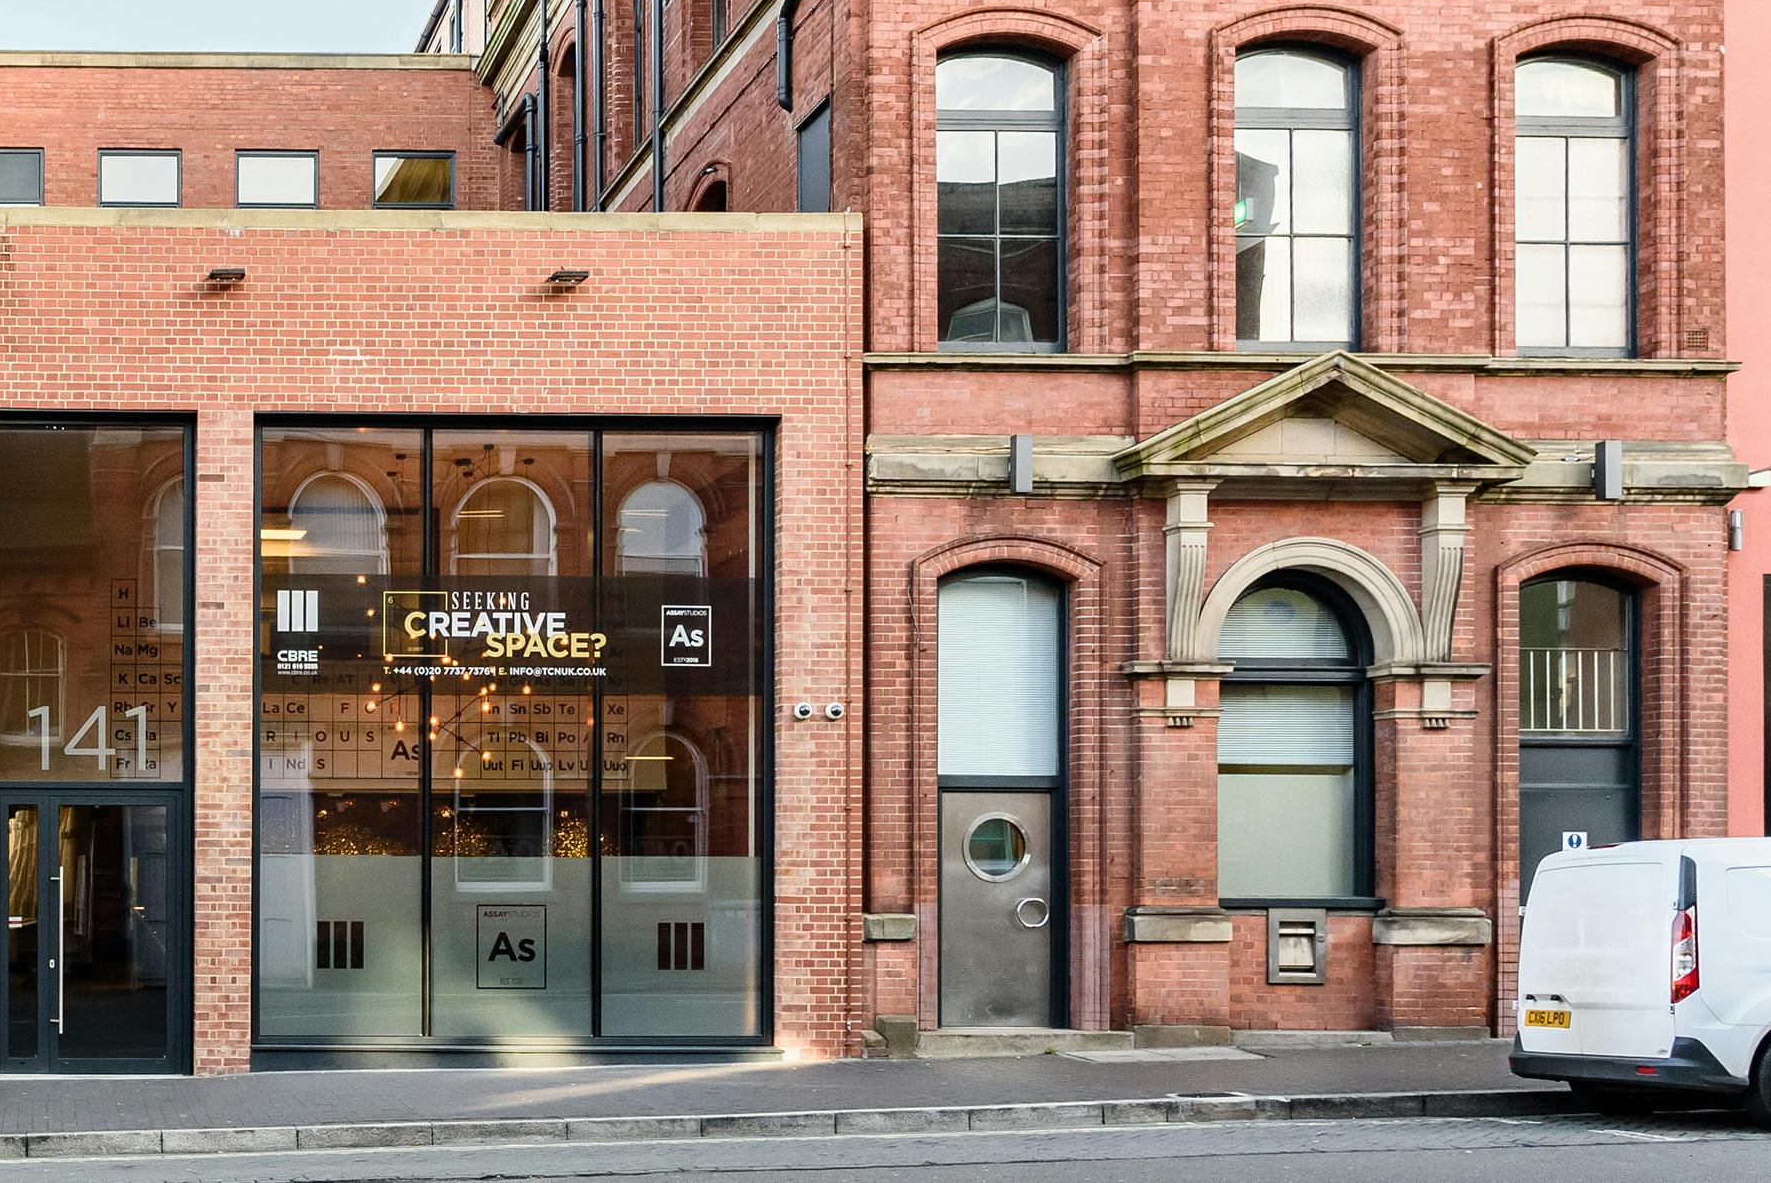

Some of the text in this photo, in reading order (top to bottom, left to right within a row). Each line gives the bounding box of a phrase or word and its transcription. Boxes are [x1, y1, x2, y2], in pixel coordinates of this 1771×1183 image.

[118, 589, 128, 599] H
[451, 592, 530, 610] SEEKING
[117, 617, 157, 628] Li Be
[404, 611, 566, 638] CREATIVE
[669, 624, 704, 647] As
[115, 644, 158, 657] Na Mg
[486, 633, 606, 658] SPACE?
[277, 650, 318, 662] CBRE
[384, 667, 391, 675] T.
[393, 667, 412, 675] +44
[414, 667, 441, 676] (0)20
[443, 667, 466, 675] 7737
[498, 668, 507, 676] E.
[509, 668, 606, 676] INFO@TCNUK.CO.UK
[119, 674, 181, 684] K Ca Sc
[167, 702, 177, 712] Y
[263, 703, 279, 713] La
[286, 703, 305, 713] Ce
[341, 703, 349, 713] F
[509, 704, 526, 714] Sn
[533, 703, 551, 715] Sb
[559, 704, 575, 715] Te
[607, 704, 624, 715] Xe
[28, 706, 147, 771] 141
[115, 729, 132, 741] Cs
[266, 731, 276, 742] R
[315, 731, 326, 742] O
[340, 731, 350, 742] U
[365, 731, 374, 742] S
[509, 732, 527, 743] Pb
[536, 732, 549, 743] Bi
[558, 732, 576, 743] Po
[607, 732, 624, 743] Rn
[116, 758, 131, 769] Fr
[286, 758, 306, 769] Nd
[316, 759, 325, 769] S
[483, 760, 503, 771] Uut
[559, 760, 575, 771] Lv
[488, 931, 536, 962] As
[1547, 1012, 1565, 1026] LPO
